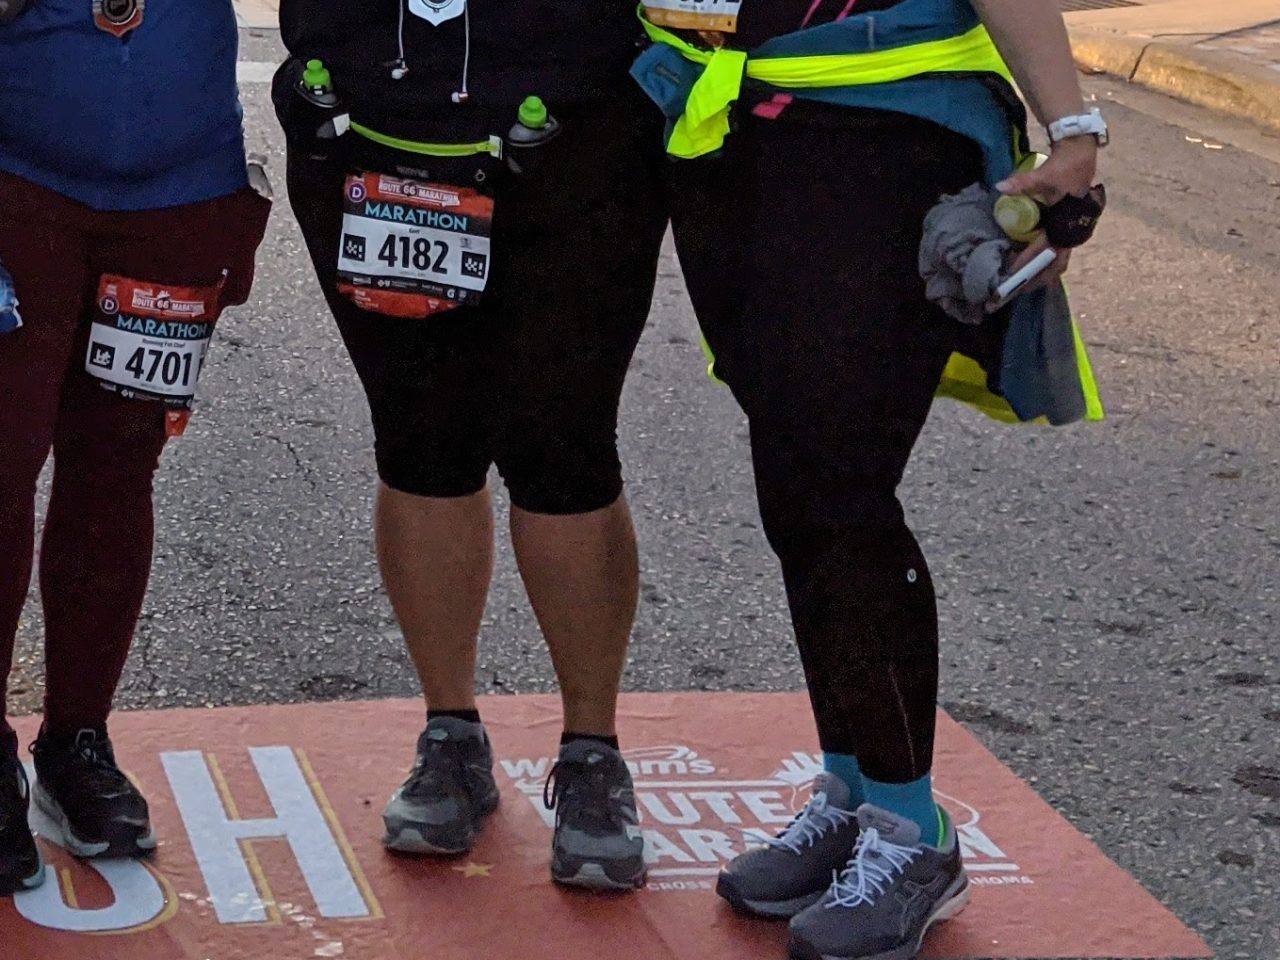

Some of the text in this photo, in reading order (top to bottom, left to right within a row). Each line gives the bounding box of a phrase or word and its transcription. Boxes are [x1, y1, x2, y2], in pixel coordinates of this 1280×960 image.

[351, 186, 362, 198] D
[403, 184, 416, 195] 66
[364, 200, 468, 231] MARATHON
[377, 233, 450, 275] 4182
[157, 299, 170, 309] 66
[116, 314, 207, 338] MARATHON
[124, 347, 193, 386] 4701
